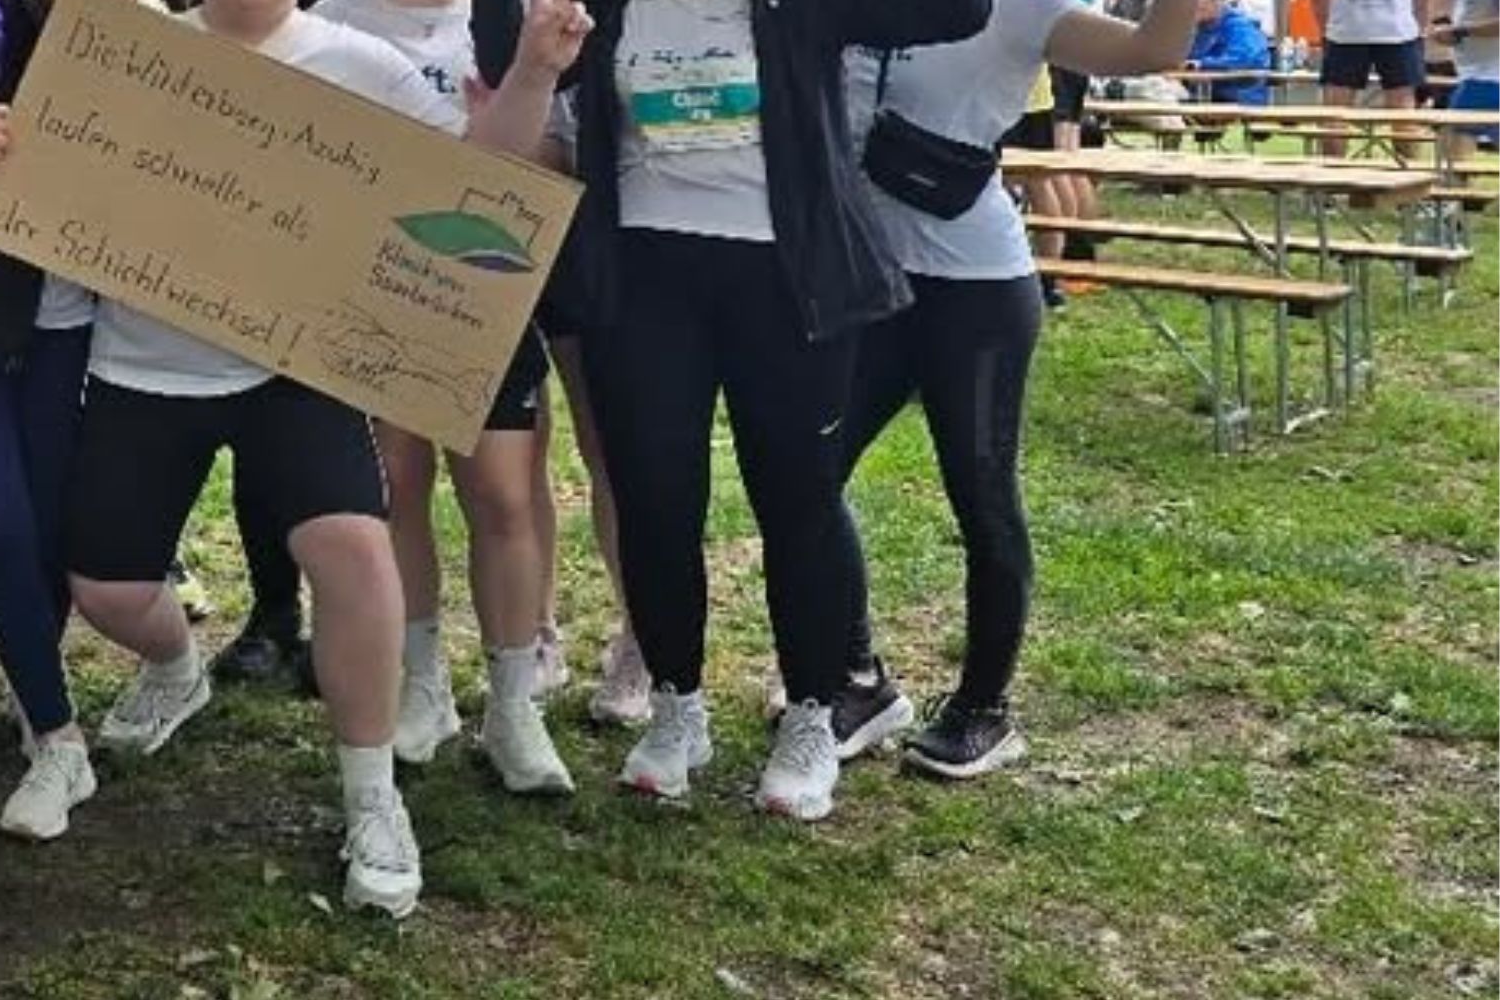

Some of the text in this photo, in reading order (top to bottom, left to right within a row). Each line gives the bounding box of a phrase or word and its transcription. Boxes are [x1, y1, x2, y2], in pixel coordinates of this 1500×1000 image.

[66, 16, 118, 71] Die
[36, 99, 309, 242] laufen schneller als
